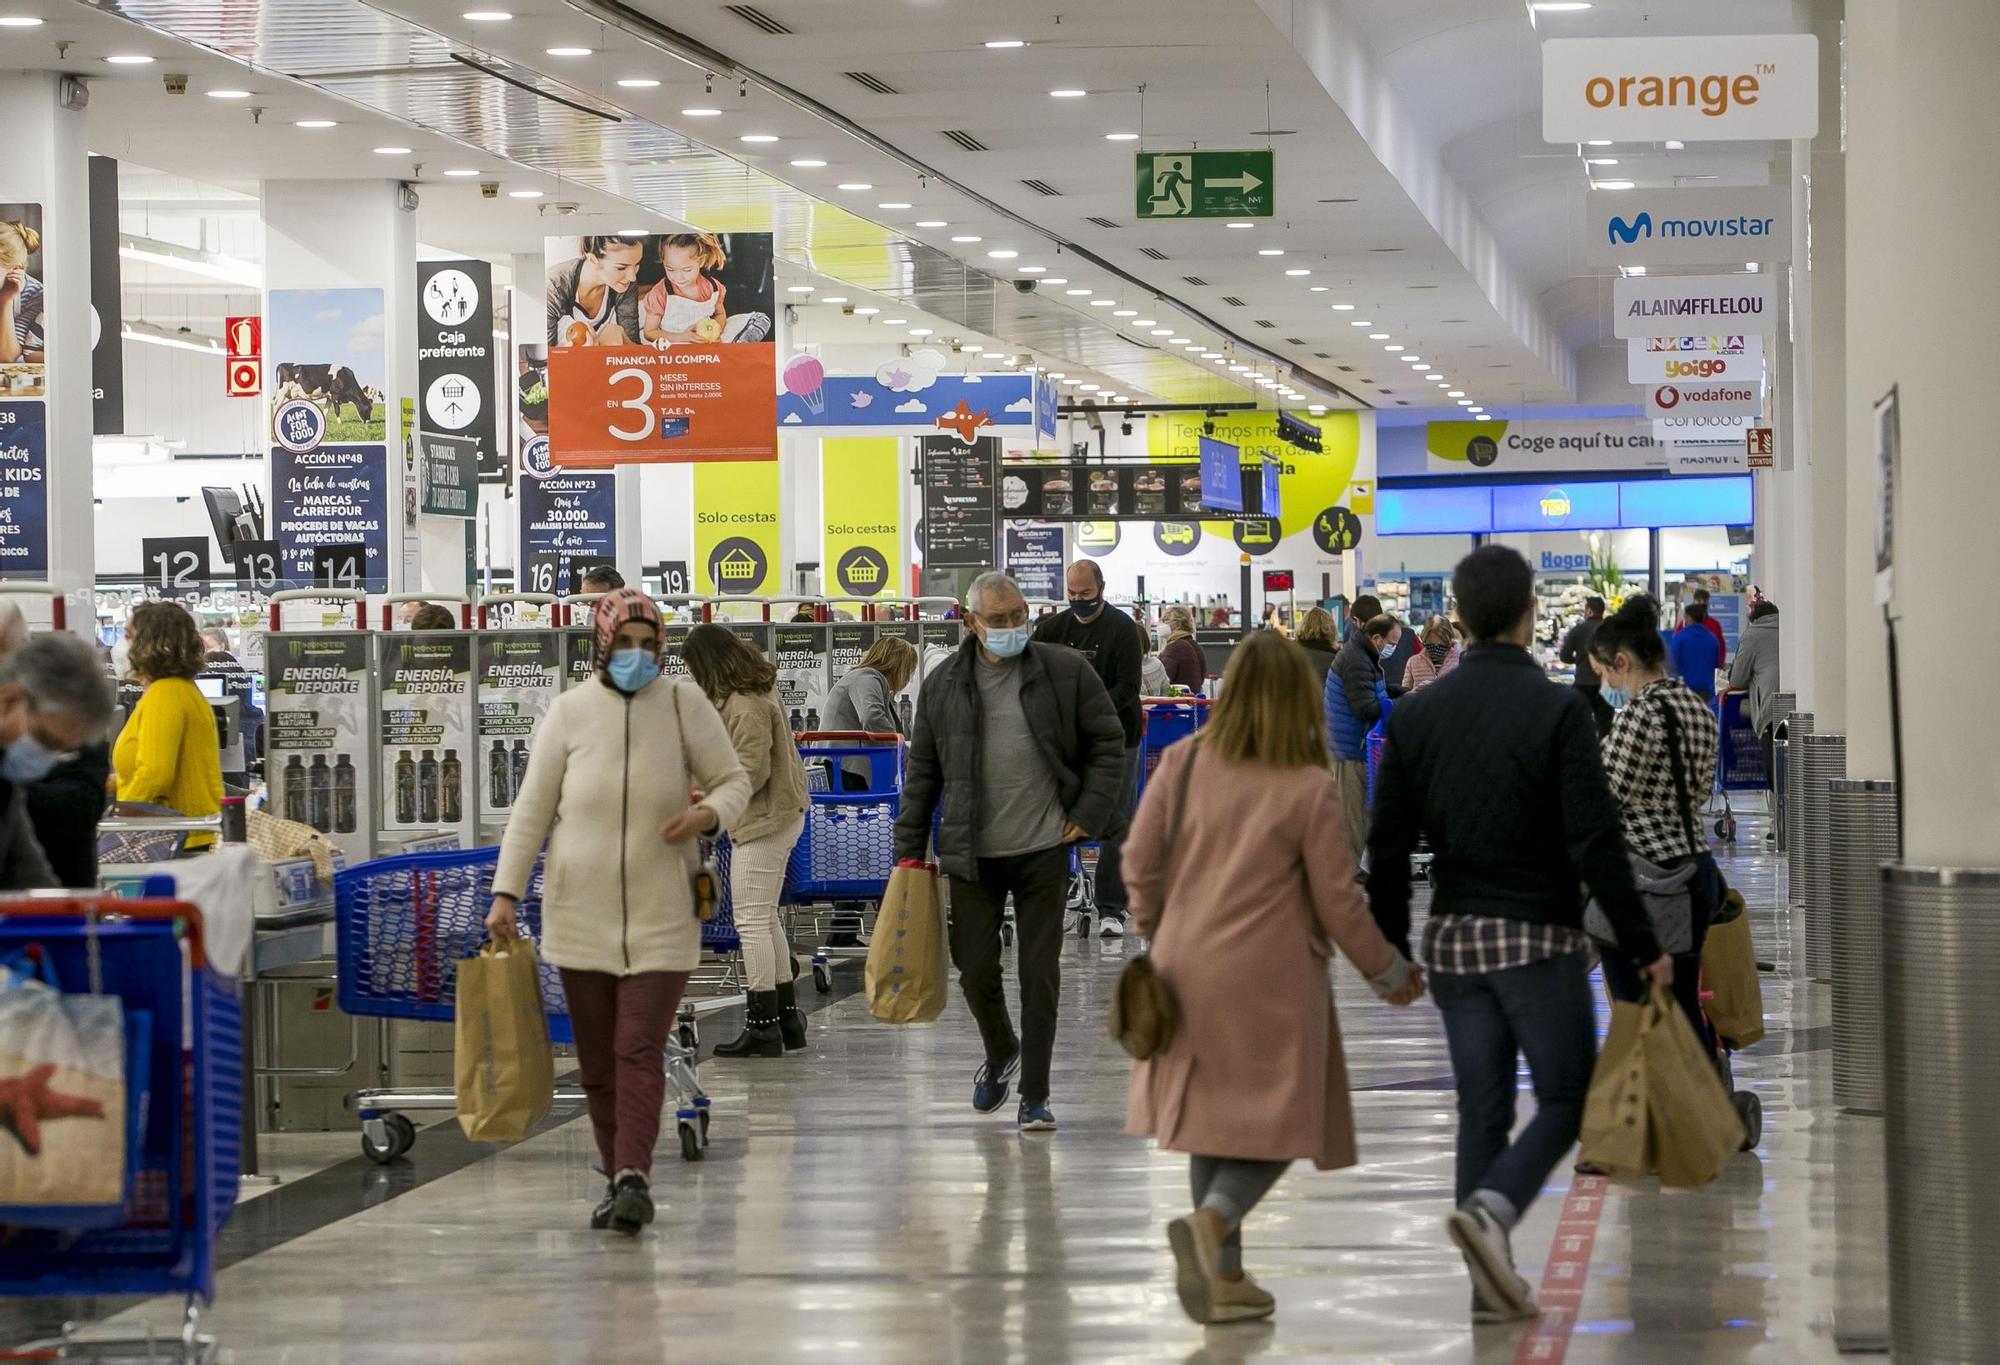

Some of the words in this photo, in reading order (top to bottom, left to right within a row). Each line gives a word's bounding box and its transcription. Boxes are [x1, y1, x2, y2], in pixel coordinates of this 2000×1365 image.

[1585, 75, 1760, 117] orange
[1754, 63, 1776, 75] TM
[1660, 216, 1774, 238] movistar
[437, 331, 466, 346] Caja
[419, 345, 486, 361] preferente
[606, 356, 656, 366] FINANCIA
[658, 355, 673, 365] TU
[675, 355, 721, 365] COMPRA
[1665, 358, 1727, 378] yoigo
[660, 373, 688, 382] MESES
[660, 383, 675, 392] SIN
[676, 382, 721, 391] INTERESES
[1683, 388, 1752, 402] vodafone
[607, 400, 619, 409] EN
[608, 368, 655, 441] 3
[289, 419, 309, 433] FOR
[1174, 423, 1258, 438] Tenmos
[289, 426, 315, 443] FOOD
[1508, 434, 1555, 453] Coge
[1558, 431, 1601, 453] aquí
[1604, 434, 1623, 449] tu
[295, 451, 336, 465] ACCIÓN
[5, 467, 42, 481] KIDS
[326, 475, 336, 489] de
[539, 479, 573, 490] ACCIÓN
[5, 486, 20, 498] DE
[303, 495, 353, 506] MARCAS
[293, 506, 363, 517] CARREFOUR
[547, 510, 589, 522] 30.000
[698, 511, 729, 524] Solo
[731, 512, 777, 524] cestas
[0, 524, 21, 535] RES
[281, 520, 329, 532] PROCEDE
[329, 520, 344, 532] DE
[344, 520, 379, 531] VACAS
[530, 521, 562, 530] ANÁLISIS
[562, 521, 573, 530] DE
[573, 521, 607, 530] CALIDAD
[827, 524, 855, 535] Solo
[856, 524, 897, 535] cestas
[294, 531, 366, 544] AUTÓCTONAS
[552, 531, 565, 547] al
[566, 536, 583, 546] año
[0, 547, 29, 556] DICOS
[297, 561, 313, 573] EN
[1540, 551, 1592, 569] Hogar
[152, 551, 200, 589] 12
[242, 553, 276, 588] 13
[321, 556, 360, 590] 14
[531, 562, 553, 593] 16
[662, 569, 683, 594] 19
[488, 661, 544, 677] ENERGÍA
[779, 659, 822, 669] DEPORTE
[283, 663, 348, 681] ENERGÍA
[394, 665, 455, 682] ENERGÍA
[294, 680, 360, 694] DEPORTE
[405, 681, 465, 694] DEPORTE
[497, 676, 553, 688] DEPORTE
[484, 717, 504, 726] ZERO
[278, 729, 300, 738] ZERO
[389, 726, 410, 735] ZERO
